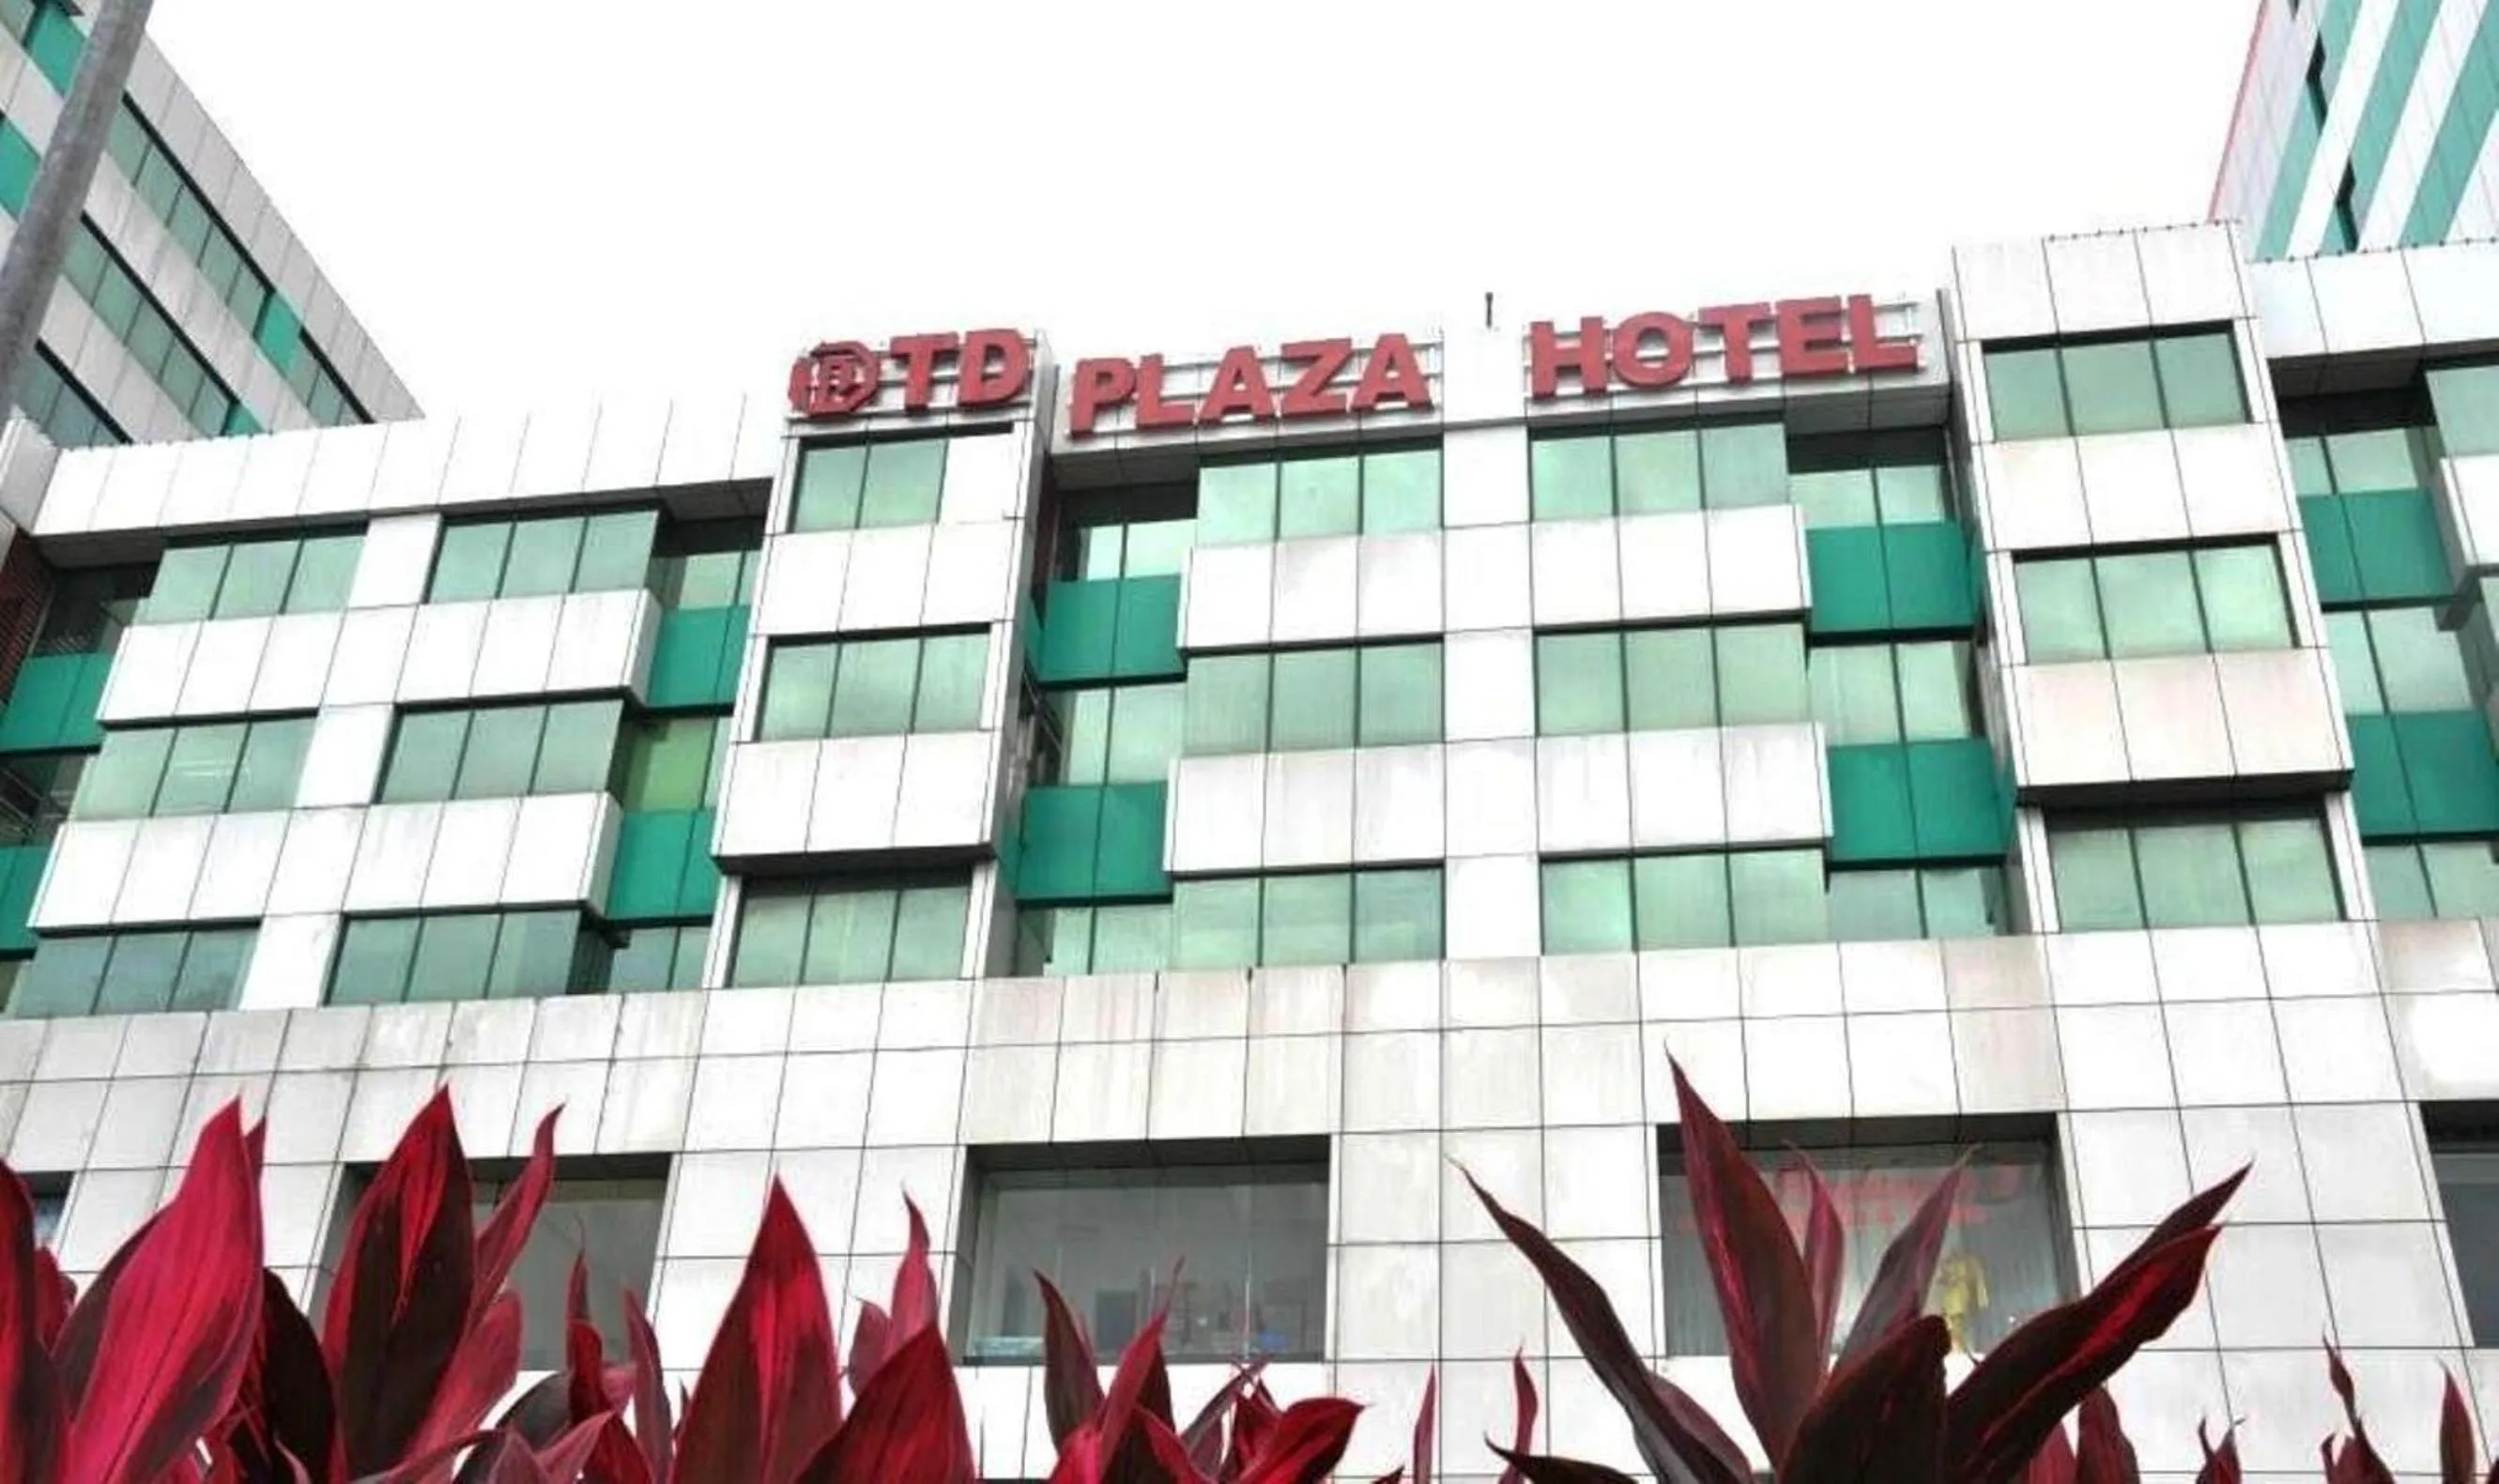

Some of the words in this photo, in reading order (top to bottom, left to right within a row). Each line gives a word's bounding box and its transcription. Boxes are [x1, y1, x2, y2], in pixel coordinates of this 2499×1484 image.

[890, 329, 1030, 410] TD
[1069, 332, 1433, 438] PLAZA
[1529, 294, 1918, 399] HOTEL
